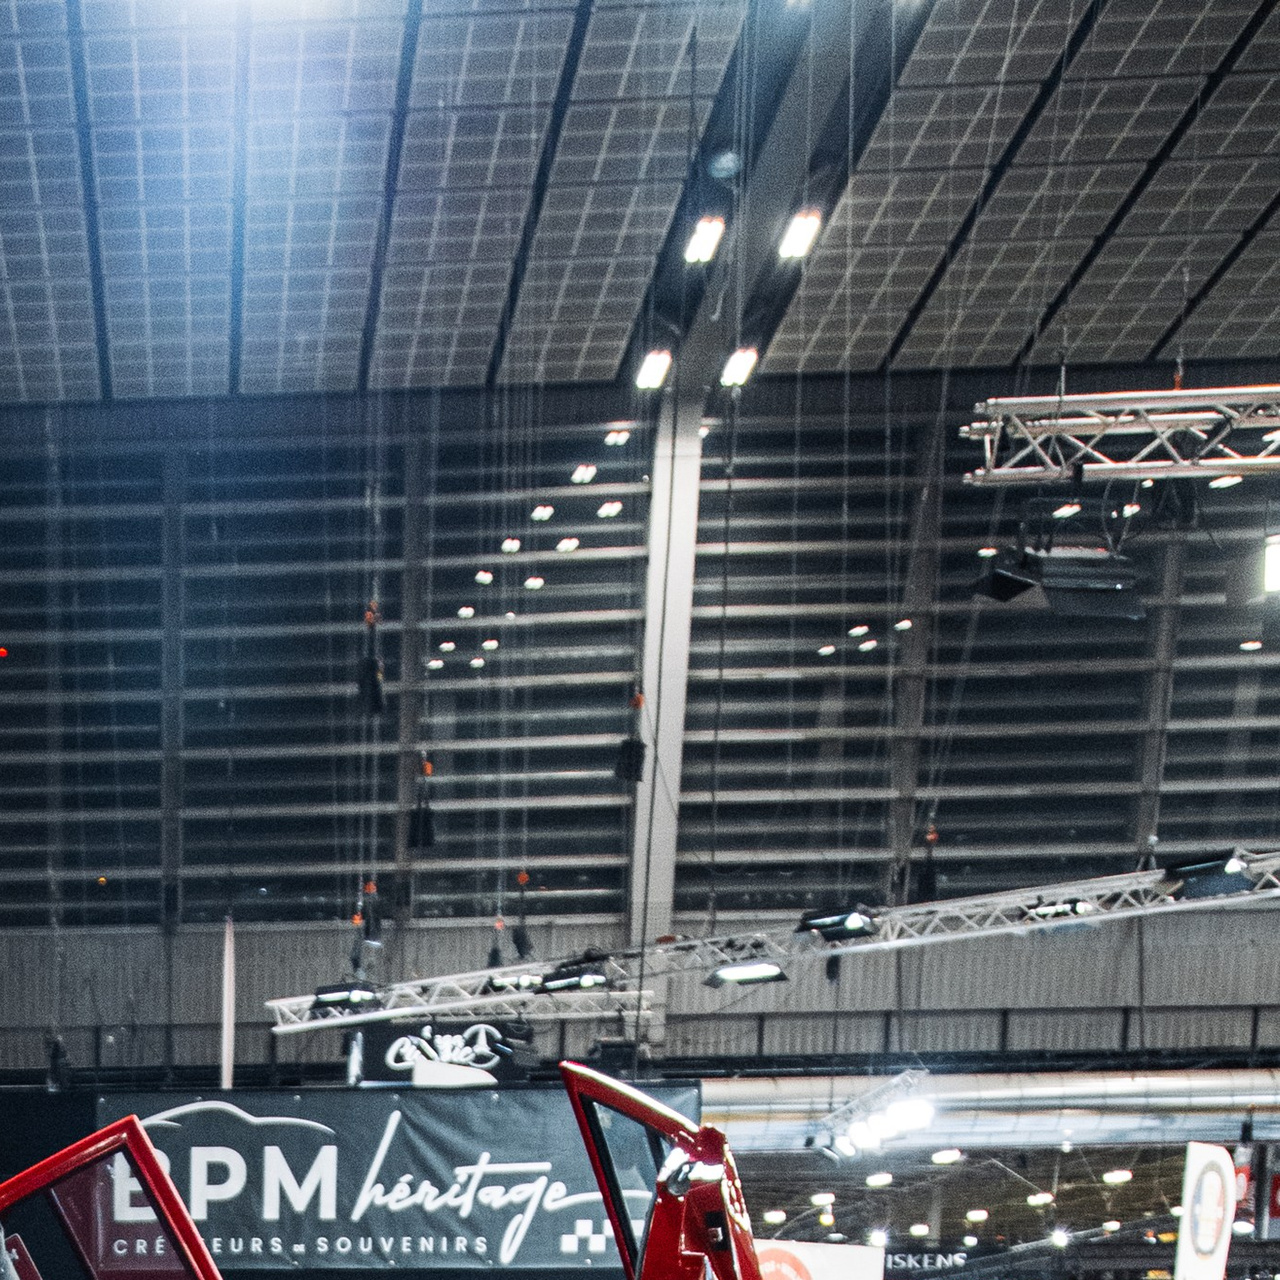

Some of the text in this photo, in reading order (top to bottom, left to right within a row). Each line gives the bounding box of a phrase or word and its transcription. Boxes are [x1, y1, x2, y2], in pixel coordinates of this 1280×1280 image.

[350, 1110, 610, 1265] héritage
[113, 1235, 283, 1254] CRÉEURS
[316, 1236, 488, 1252] SOUVENIRS
